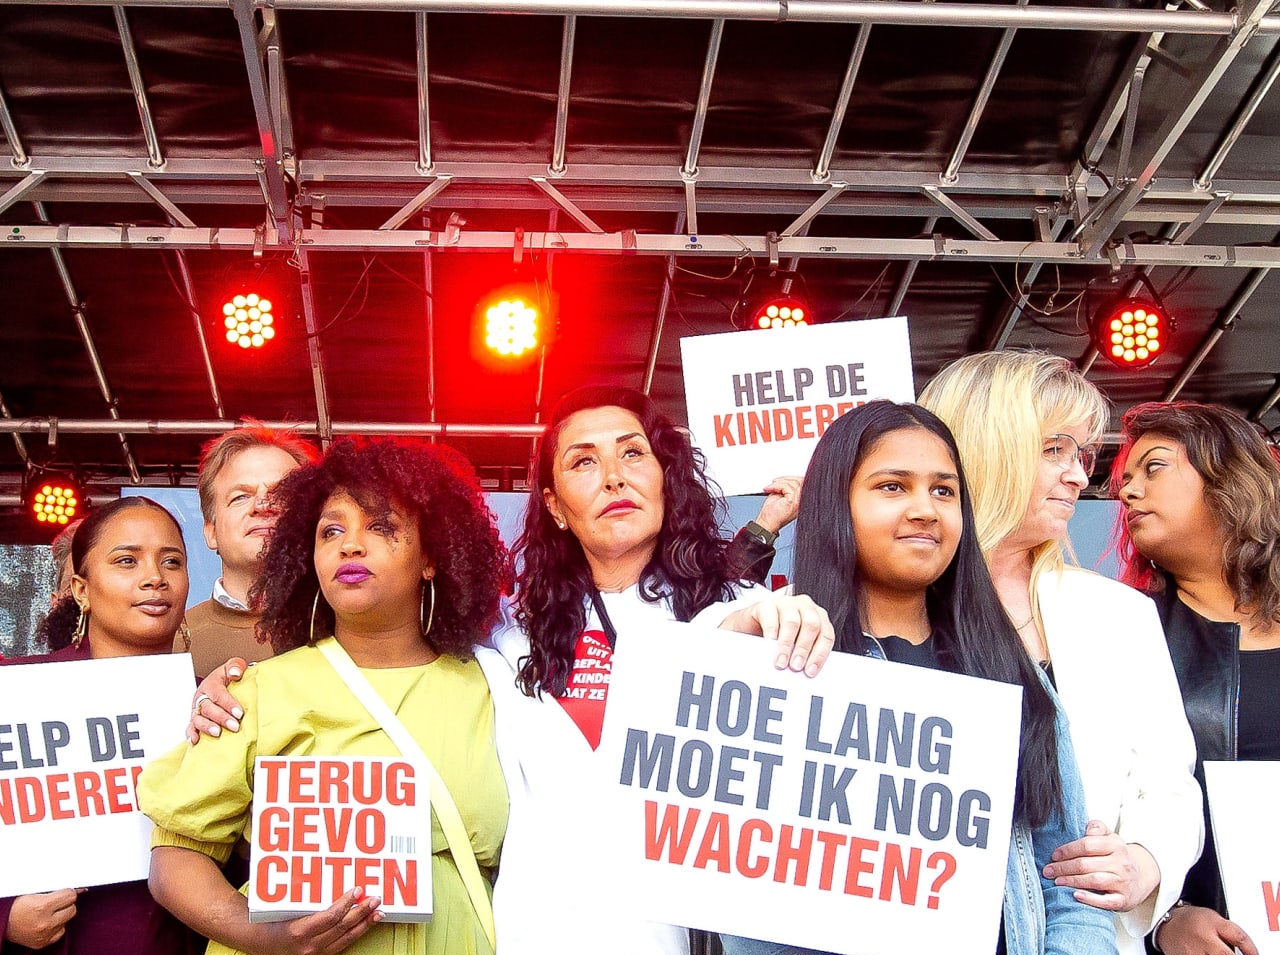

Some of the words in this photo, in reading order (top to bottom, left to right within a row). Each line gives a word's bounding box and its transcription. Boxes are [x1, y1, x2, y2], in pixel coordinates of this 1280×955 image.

[733, 368, 813, 407] HELP
[826, 363, 867, 398] DE
[714, 402, 865, 448] KINDER
[588, 688, 606, 700] ZE
[86, 714, 144, 762] DE
[676, 671, 787, 745] HOE
[806, 695, 952, 777] LANG
[261, 761, 415, 806] TERUG
[620, 729, 783, 810] MOET
[799, 760, 857, 825] IK
[874, 774, 991, 849] NOG
[259, 807, 385, 854] GEVO
[645, 800, 956, 909] WACHTEN?
[256, 856, 417, 906] CHTEN
